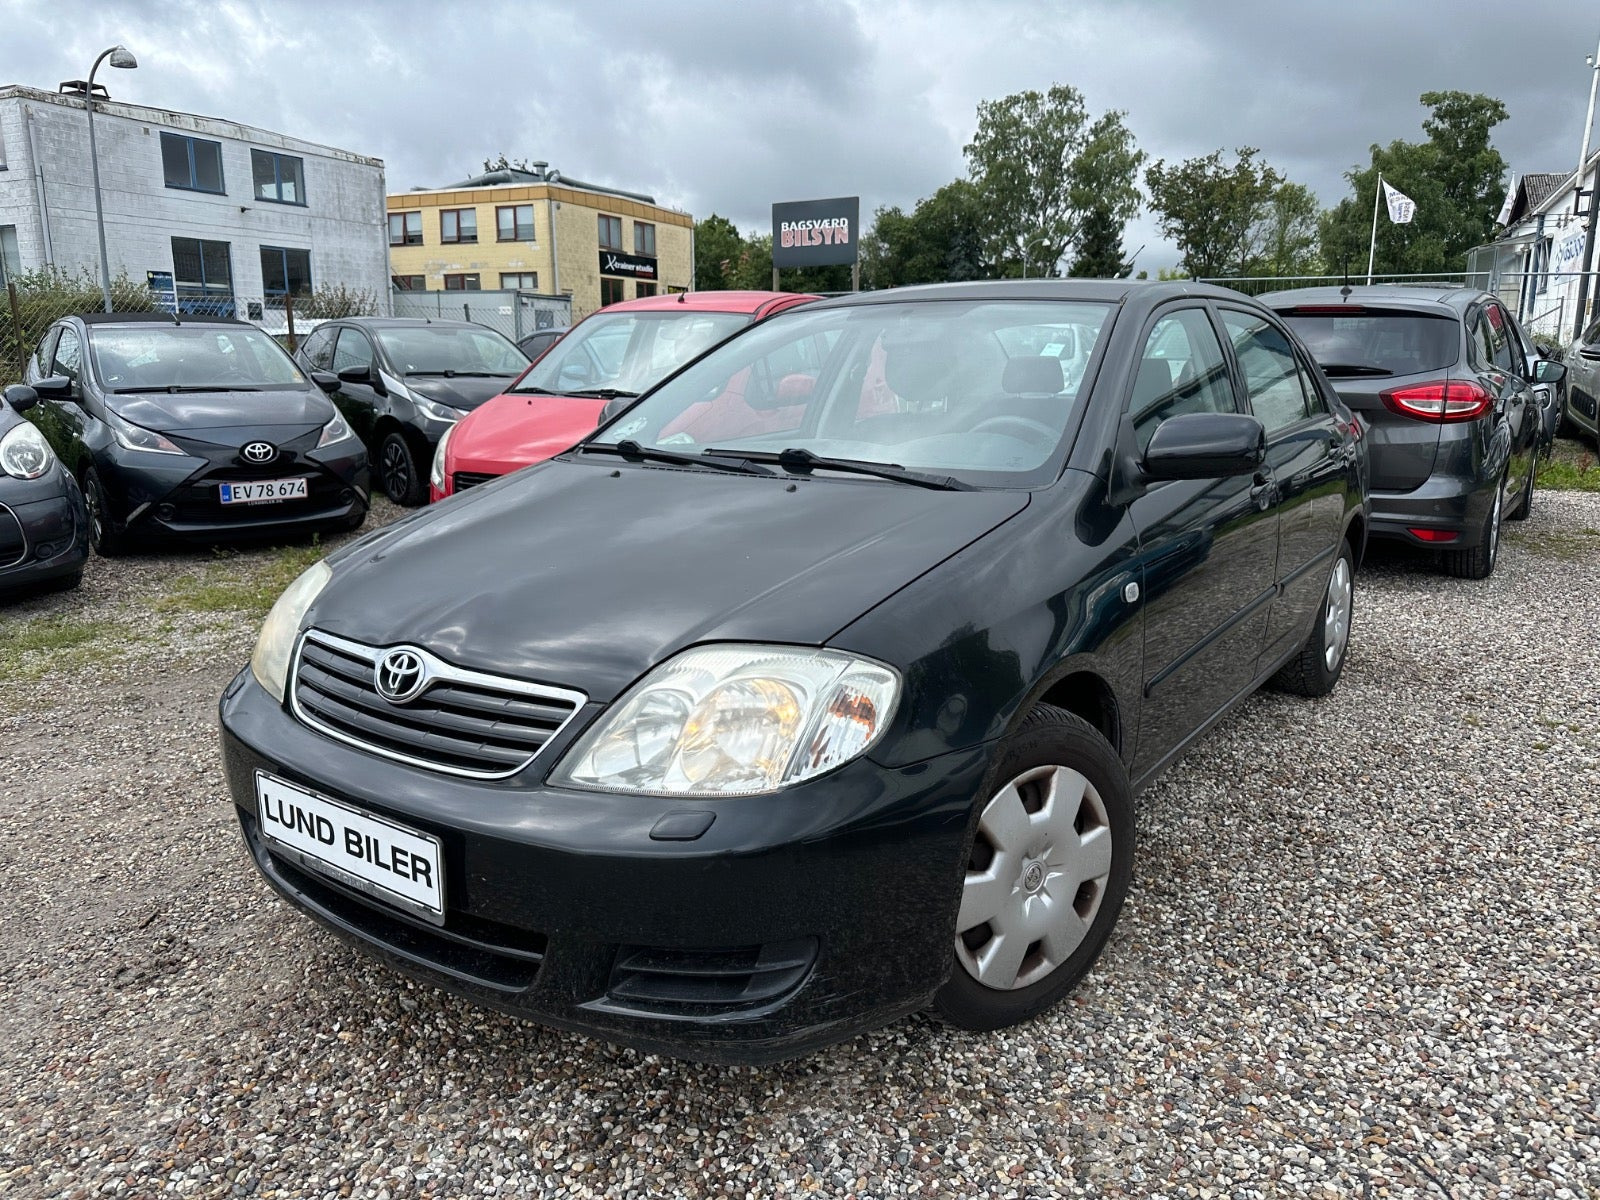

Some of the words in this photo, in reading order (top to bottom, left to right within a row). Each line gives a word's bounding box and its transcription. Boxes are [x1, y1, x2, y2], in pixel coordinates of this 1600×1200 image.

[781, 218, 848, 231] BAGSVÆRD
[781, 226, 849, 248] BILSYN
[605, 254, 635, 271] X-trainer
[636, 264, 654, 273] studio
[233, 486, 253, 499] EV
[257, 484, 274, 497] 78
[279, 481, 305, 496] 674
[263, 793, 335, 846] LUND
[344, 826, 433, 889] BILER
